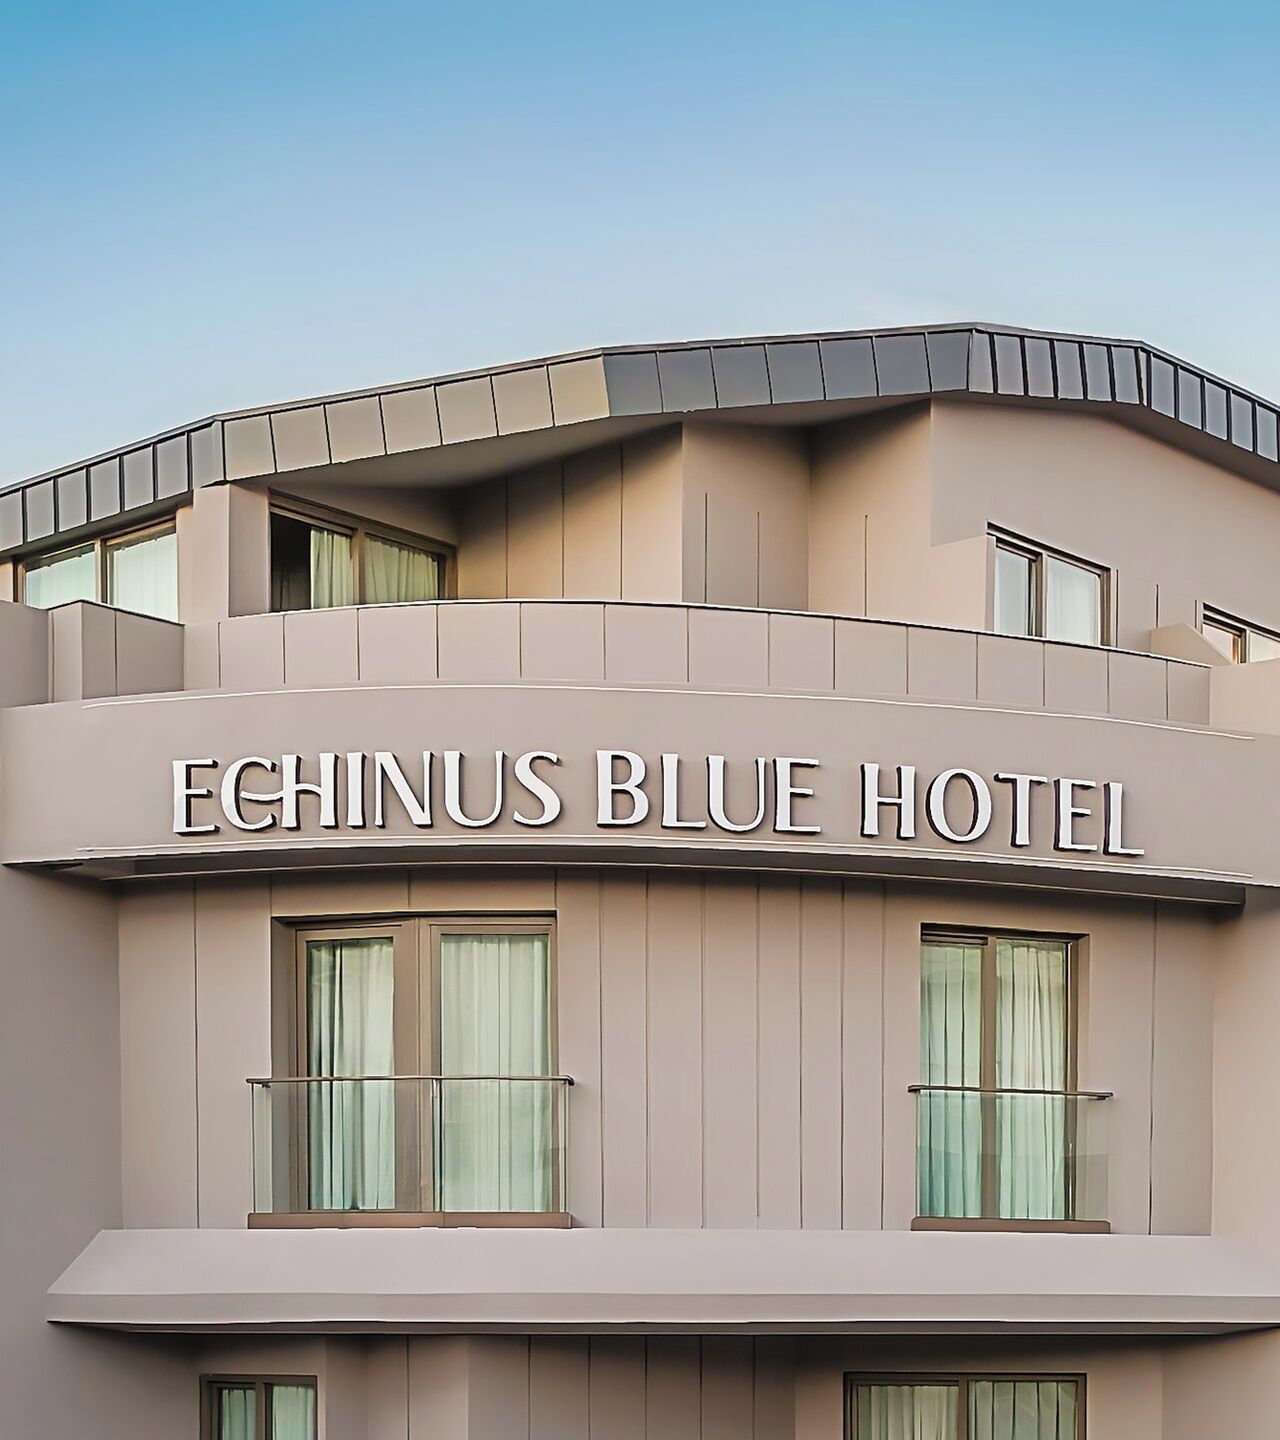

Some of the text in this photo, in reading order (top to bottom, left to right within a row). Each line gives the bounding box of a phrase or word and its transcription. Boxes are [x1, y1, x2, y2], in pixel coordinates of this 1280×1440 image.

[171, 750, 1144, 857] ECHINUS BLUE HOTEL
